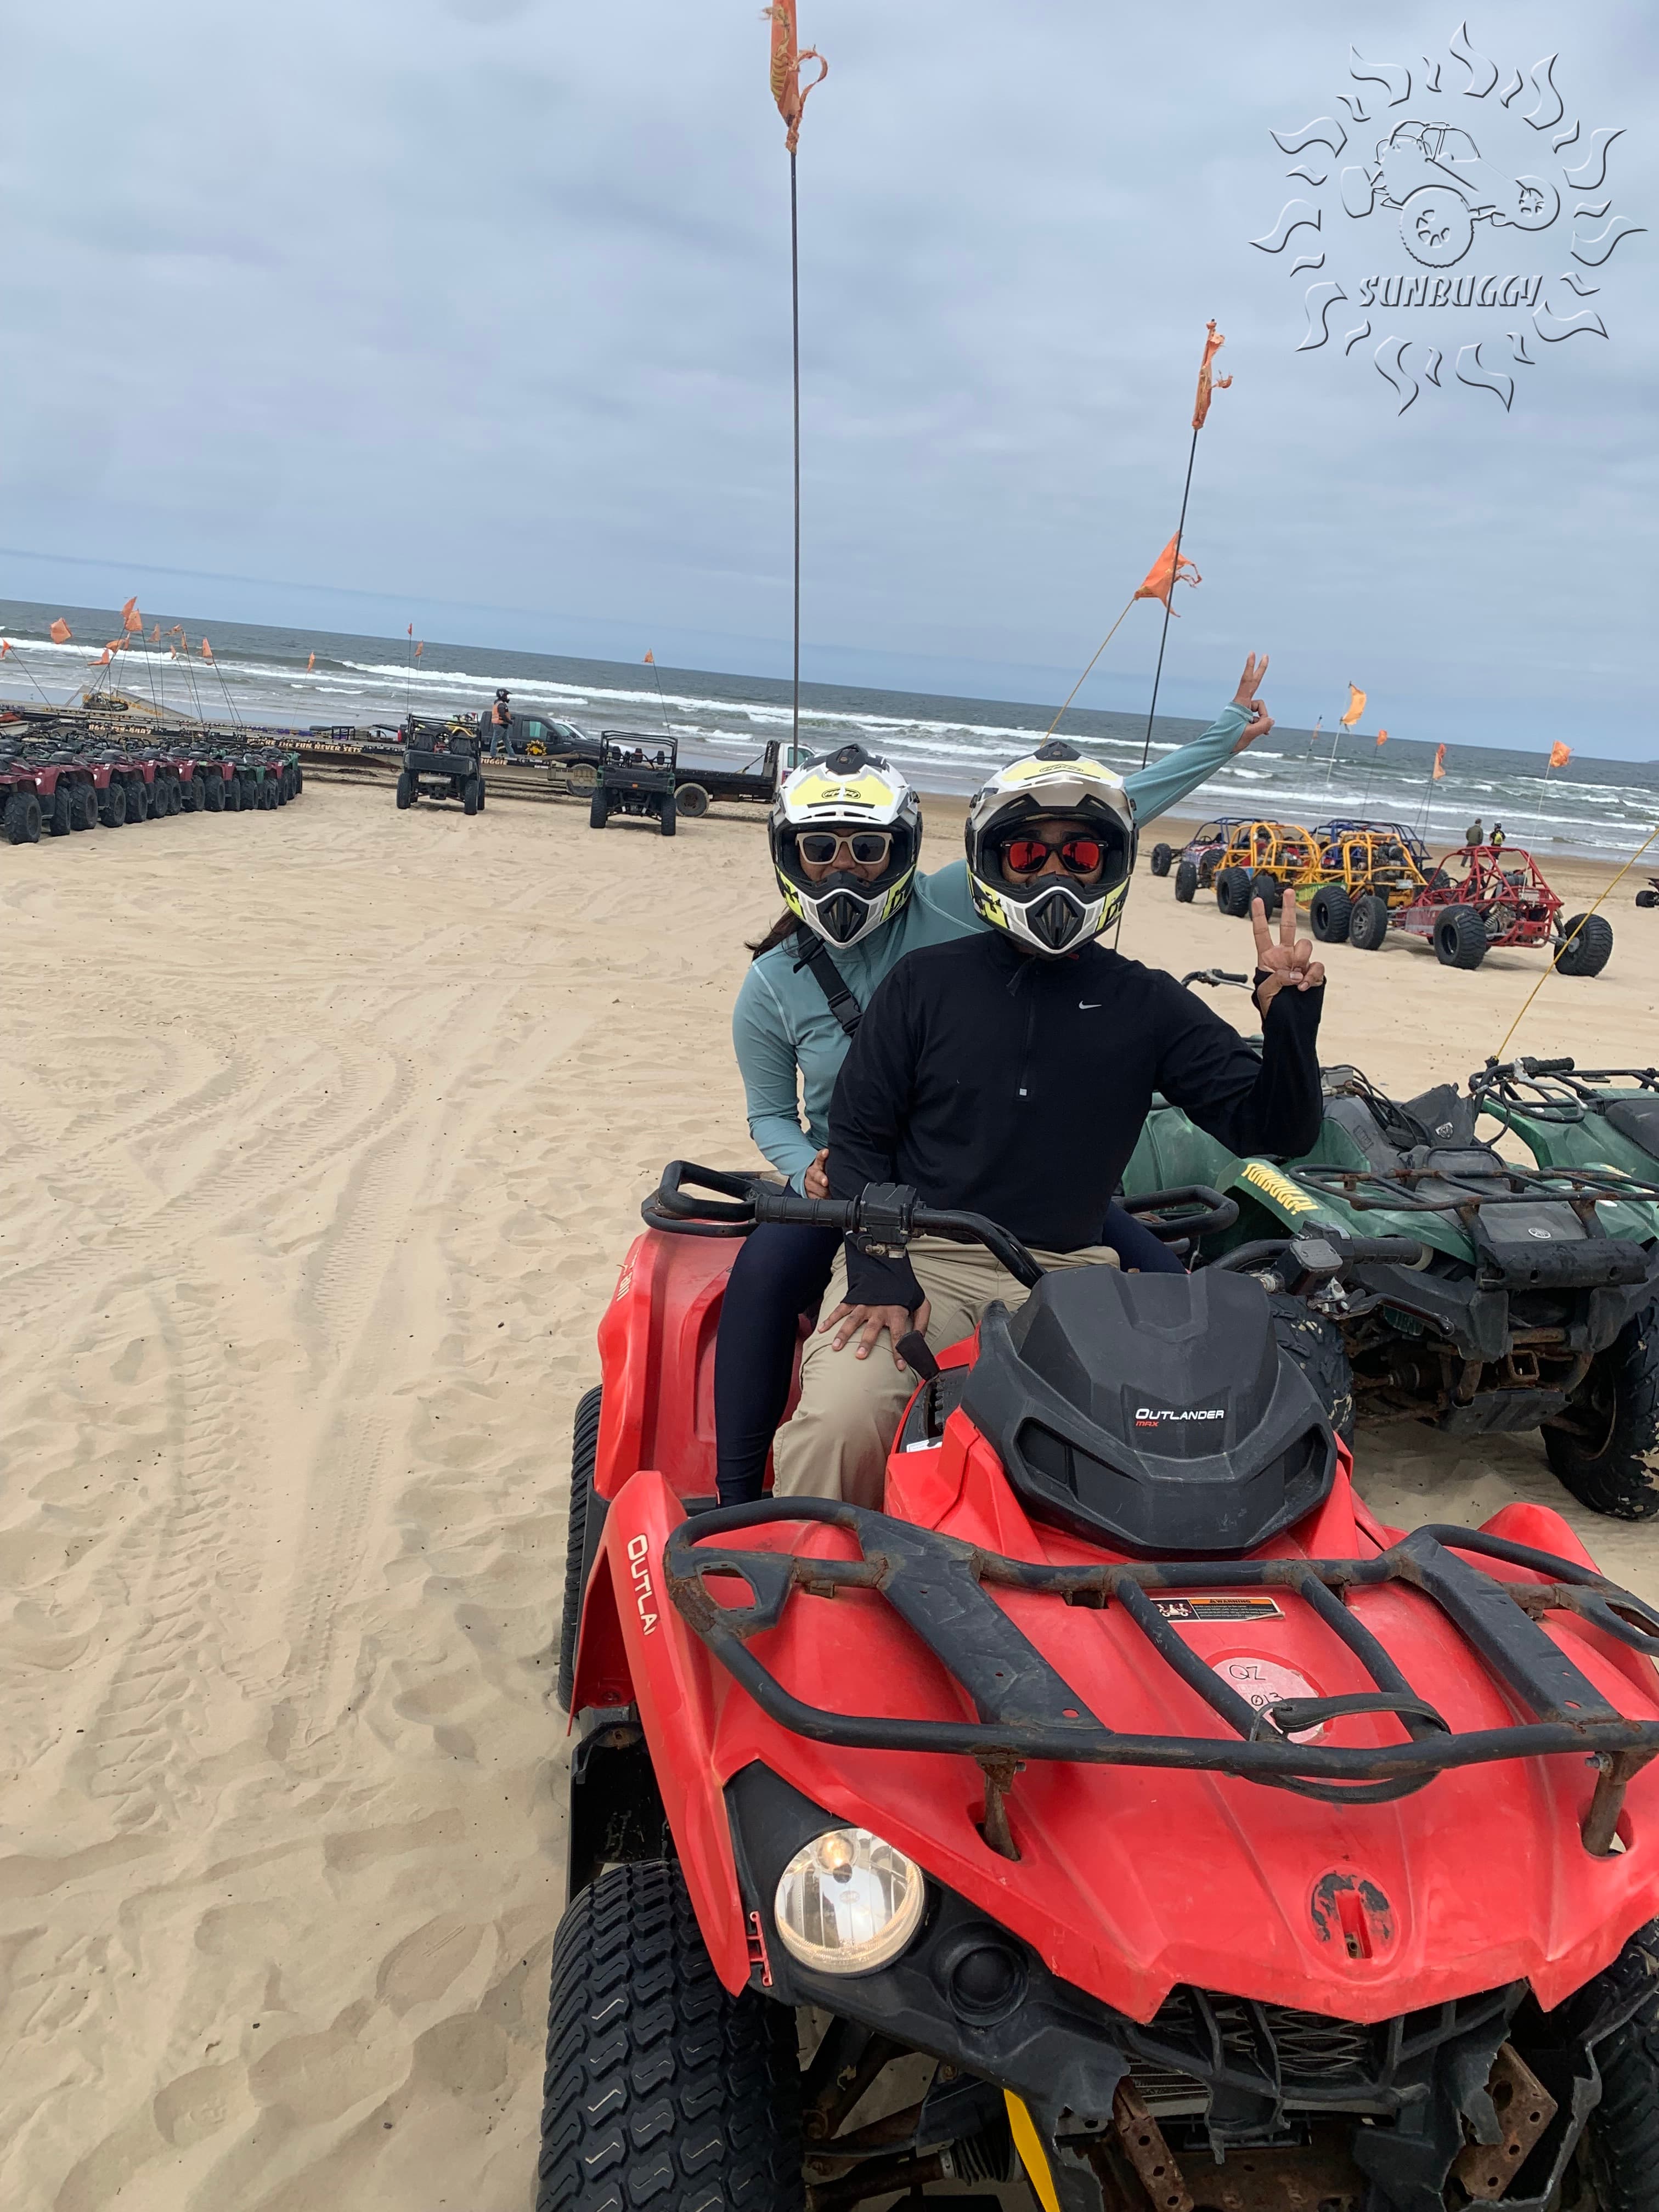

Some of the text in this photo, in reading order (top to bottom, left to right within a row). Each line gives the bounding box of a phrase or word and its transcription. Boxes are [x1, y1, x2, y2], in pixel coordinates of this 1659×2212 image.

[1135, 1408, 1224, 1420] OUTLANDER
[627, 1534, 657, 1635] OUTLA
[1229, 1664, 1266, 1680] QZ
